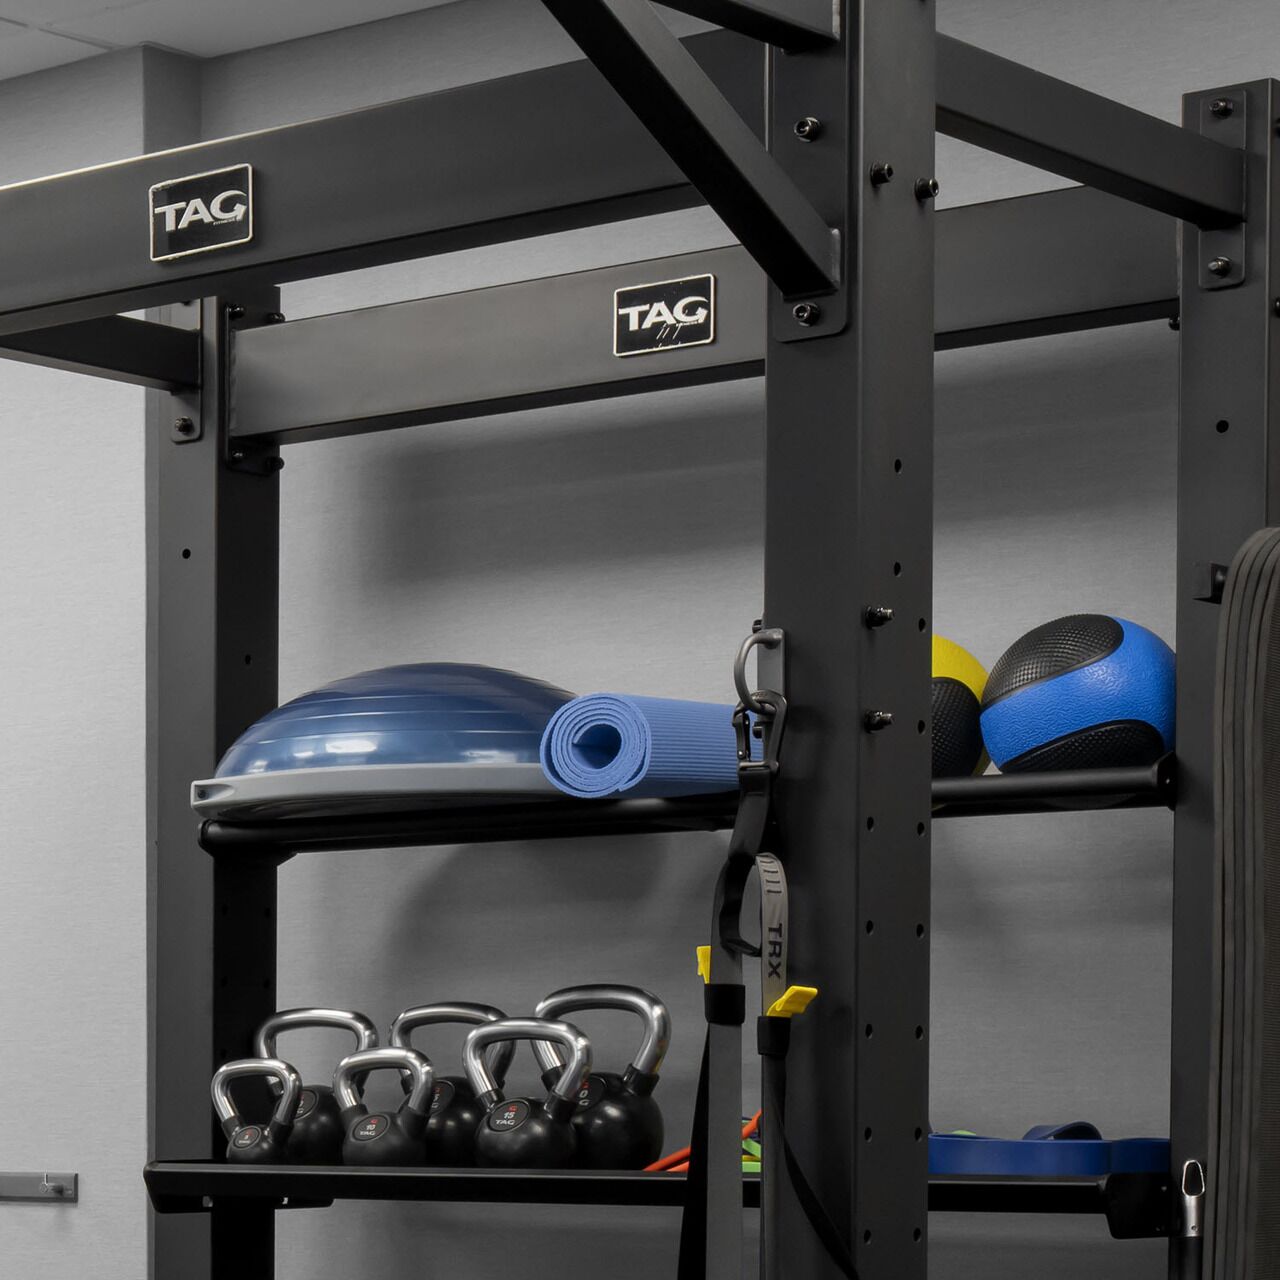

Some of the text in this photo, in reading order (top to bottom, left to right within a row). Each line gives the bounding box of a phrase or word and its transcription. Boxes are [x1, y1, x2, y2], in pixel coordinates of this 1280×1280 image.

[154, 189, 248, 233] TAG
[618, 295, 709, 332] TAG
[767, 922, 783, 980] TRX
